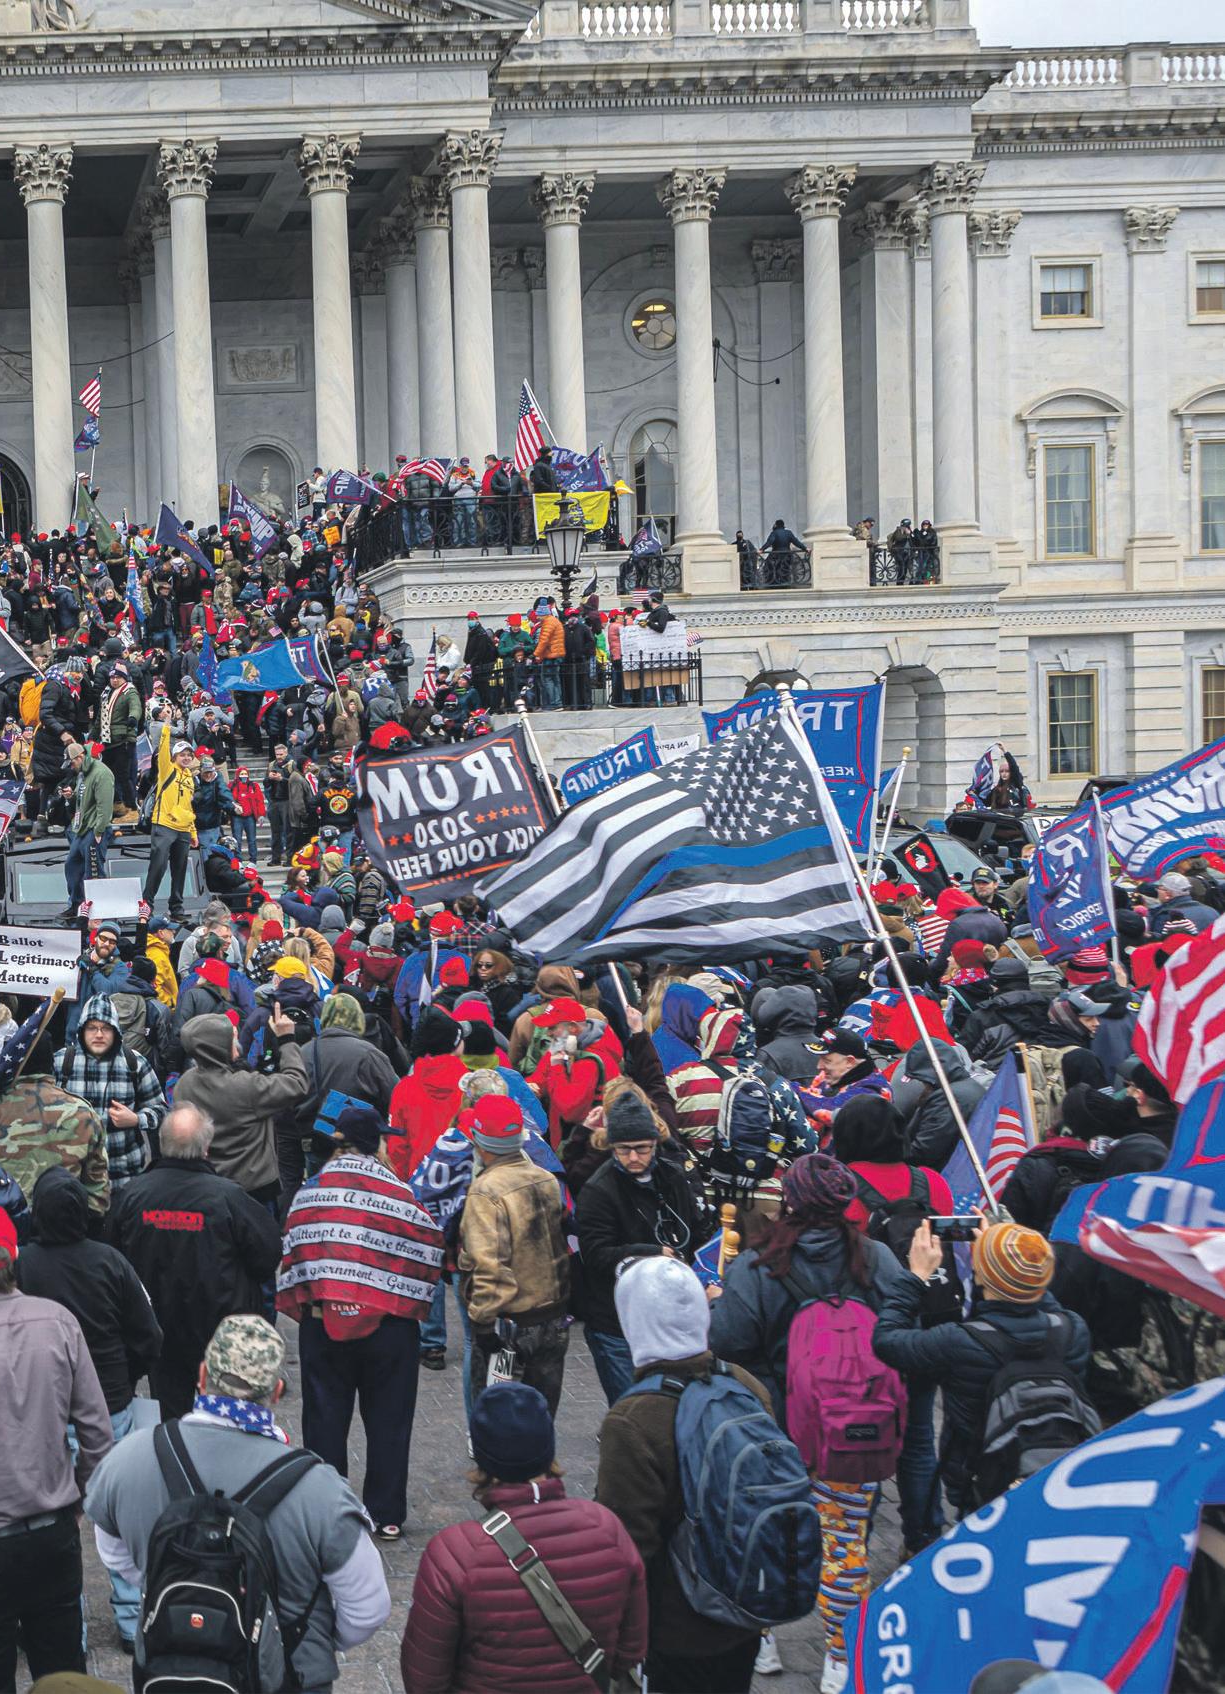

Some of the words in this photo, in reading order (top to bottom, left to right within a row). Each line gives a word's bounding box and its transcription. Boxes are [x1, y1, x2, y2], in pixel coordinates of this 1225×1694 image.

[359, 1194, 401, 1213] status
[404, 1208, 420, 1223] of
[338, 1228, 352, 1238] to
[356, 1232, 393, 1249] abuse
[395, 1240, 427, 1261] them,
